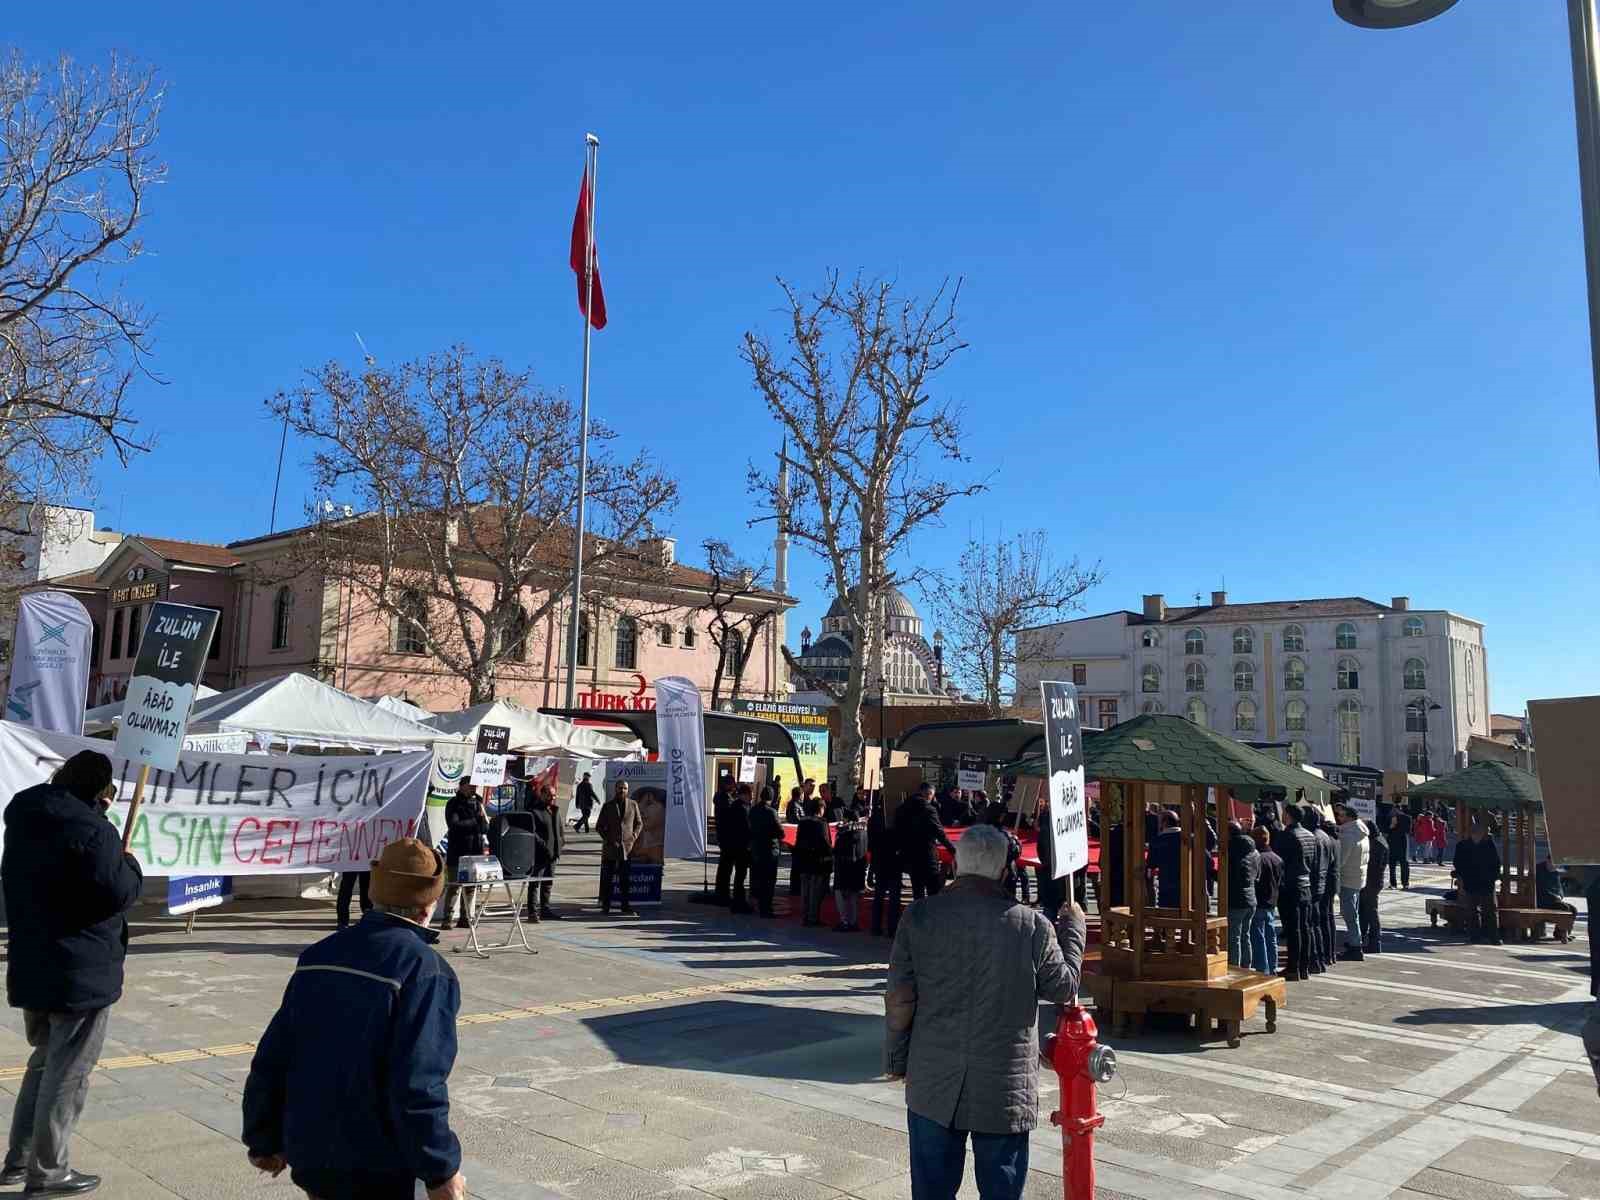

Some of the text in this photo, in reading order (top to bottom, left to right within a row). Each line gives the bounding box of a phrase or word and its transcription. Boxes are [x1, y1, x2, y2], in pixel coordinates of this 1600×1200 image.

[155, 615, 202, 640] ZULÜM
[157, 642, 182, 669] İLE
[577, 689, 627, 711] TÜRK
[1051, 691, 1075, 719] ZULÜM
[127, 711, 180, 739] OLUNMAZ!
[1060, 728, 1073, 757] İLE
[36, 757, 393, 812] LİMLER İÇİN
[105, 811, 228, 866] ASIN
